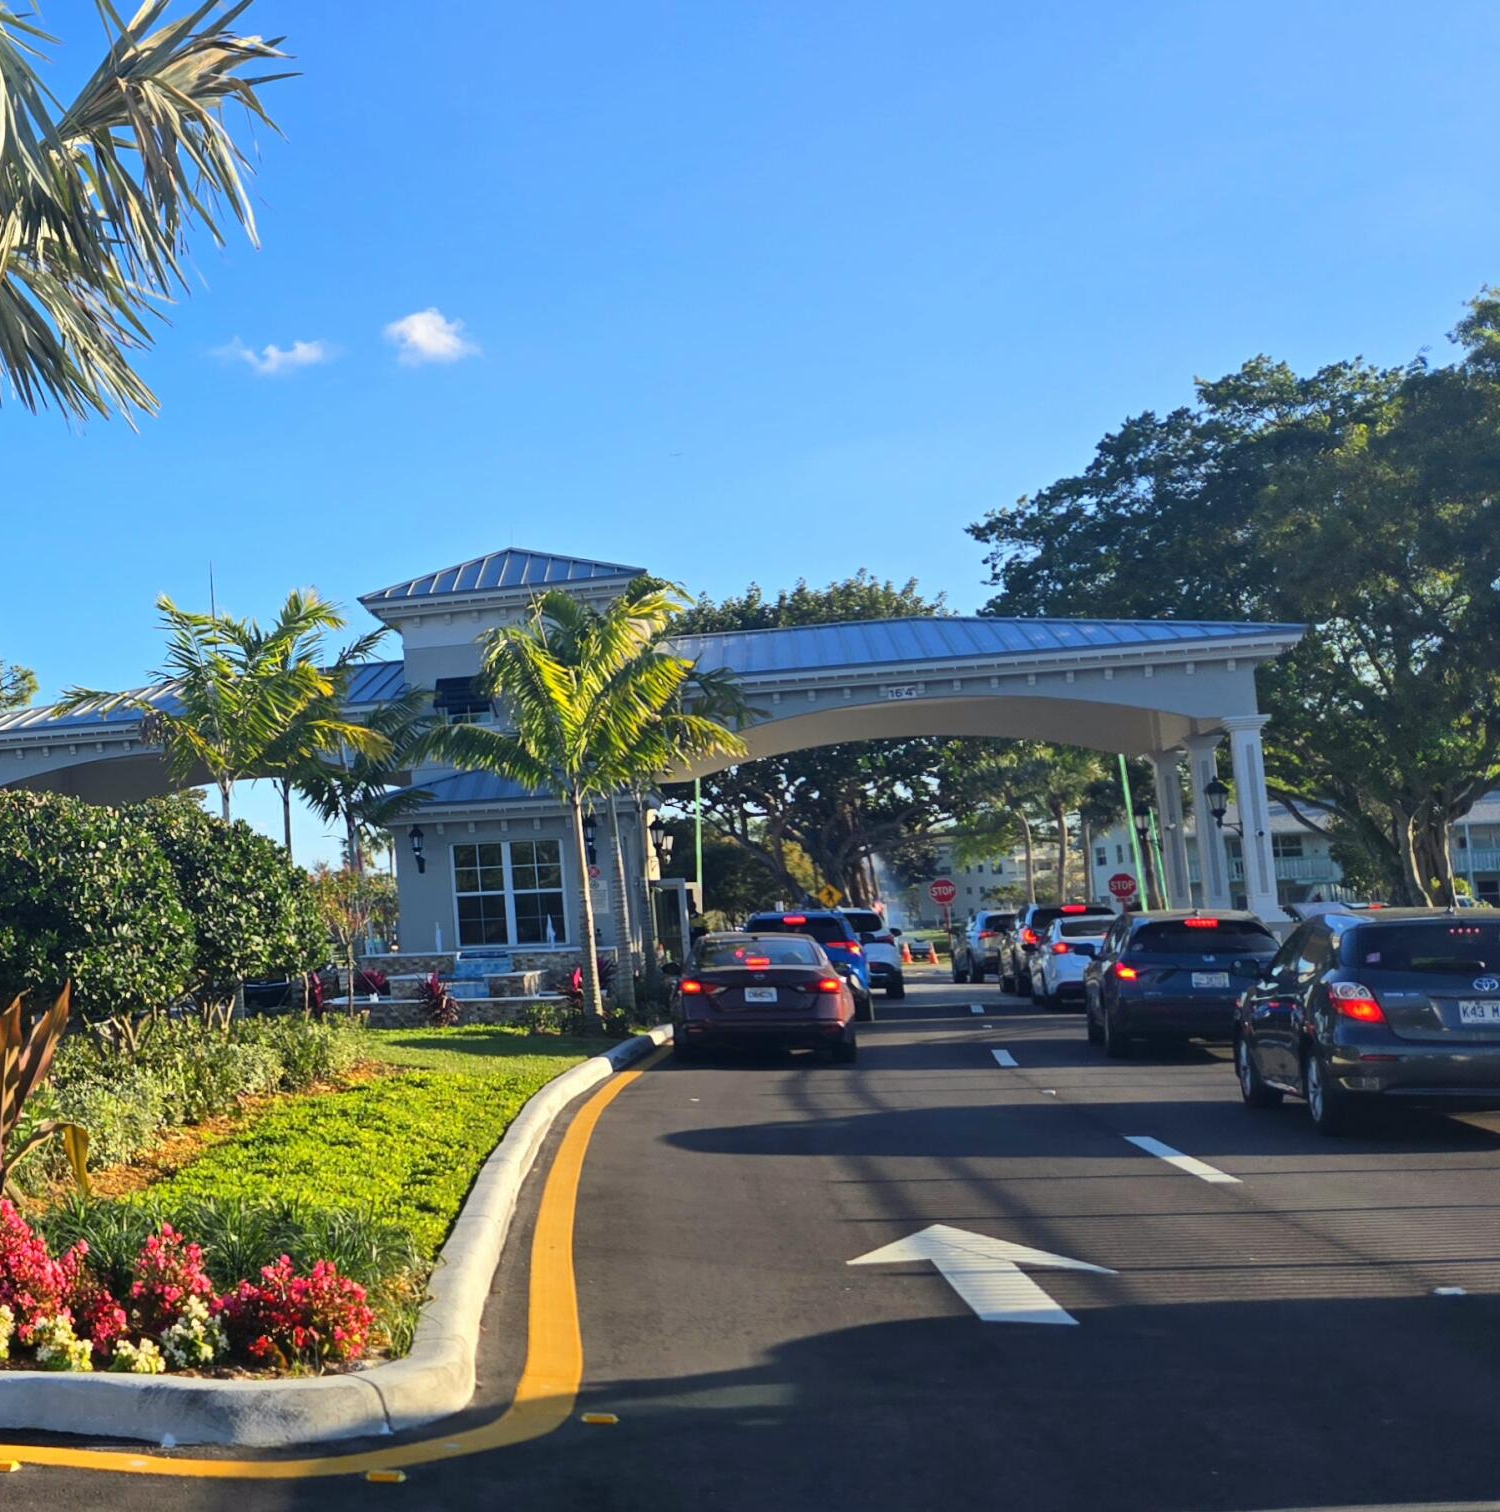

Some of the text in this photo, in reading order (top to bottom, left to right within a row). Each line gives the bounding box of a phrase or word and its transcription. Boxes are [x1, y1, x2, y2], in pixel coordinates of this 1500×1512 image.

[1111, 880, 1134, 890] STOP
[931, 886, 954, 896] STOP
[1462, 1006, 1485, 1018] K43
